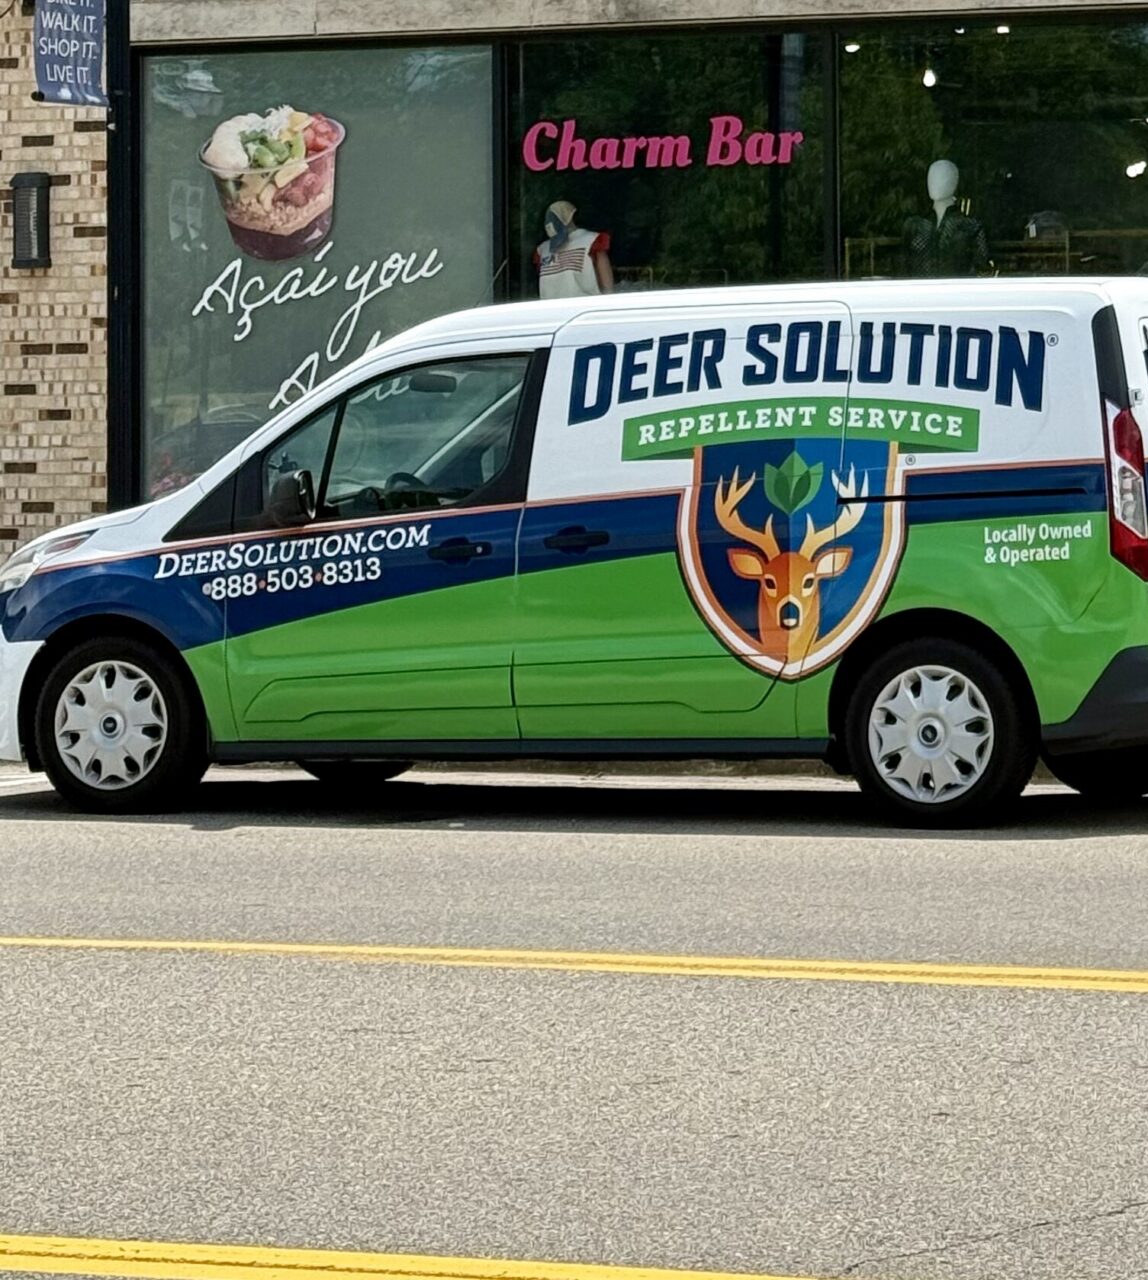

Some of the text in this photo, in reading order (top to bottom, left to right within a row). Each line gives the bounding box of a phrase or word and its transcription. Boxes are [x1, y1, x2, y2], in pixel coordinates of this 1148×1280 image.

[41, 11, 97, 34] WALK IT.
[39, 37, 97, 59] SHOP IT.
[46, 64, 92, 86] LIVE IT.
[523, 115, 803, 170] Charm Bar
[192, 241, 443, 362] Açaí you
[567, 320, 1046, 427] DEER SOLUTION
[638, 406, 963, 446] REPELLENT SERVICE
[984, 520, 1092, 545] Locally Owned
[984, 542, 1069, 567] & Operated
